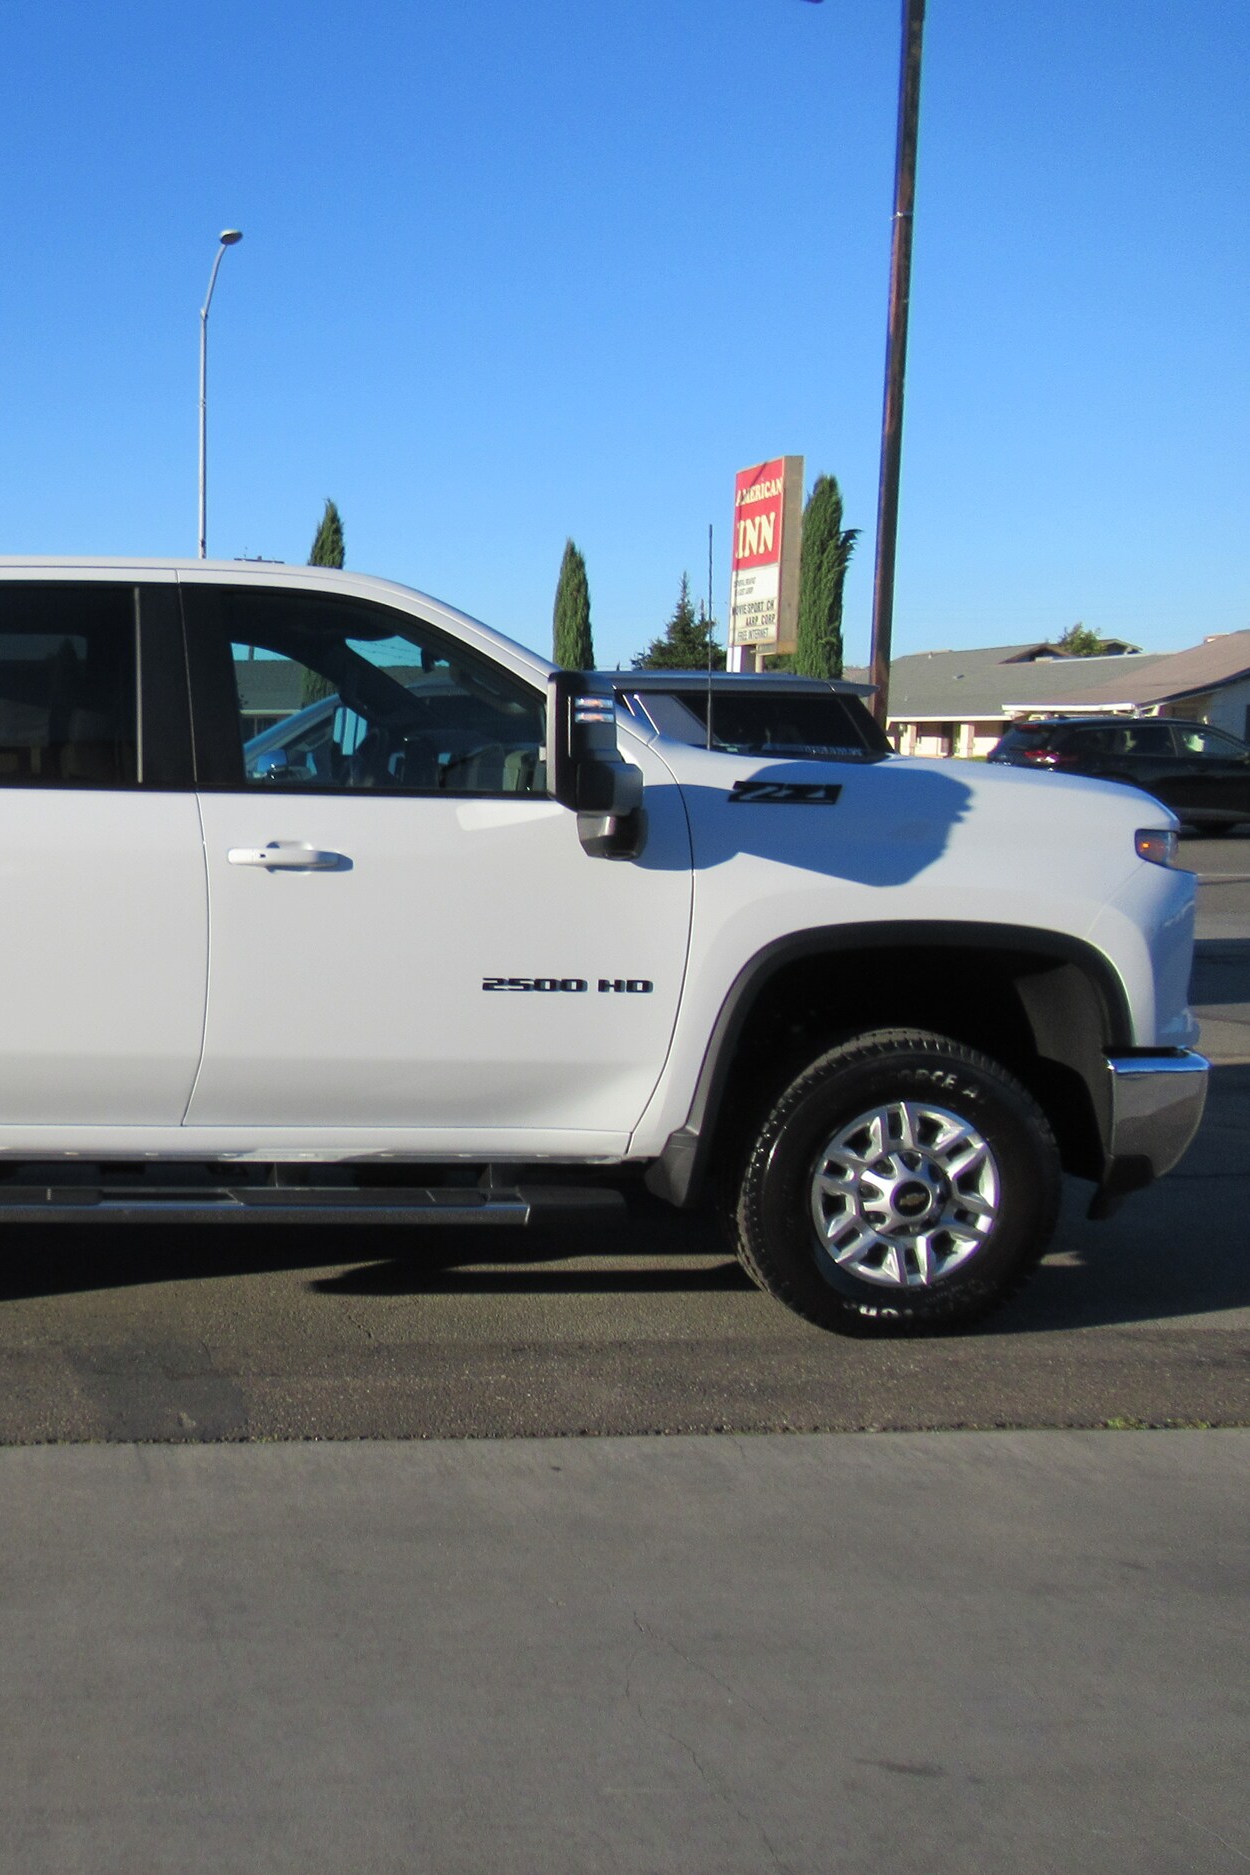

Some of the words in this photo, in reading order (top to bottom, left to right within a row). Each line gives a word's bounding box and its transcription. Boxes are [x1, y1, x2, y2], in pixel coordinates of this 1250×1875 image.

[735, 477, 783, 507] AMERICAN
[735, 511, 776, 560] INN
[761, 613, 776, 626] CORP
[727, 780, 843, 805] Z71
[482, 977, 588, 993] 2500
[598, 979, 654, 993] HD
